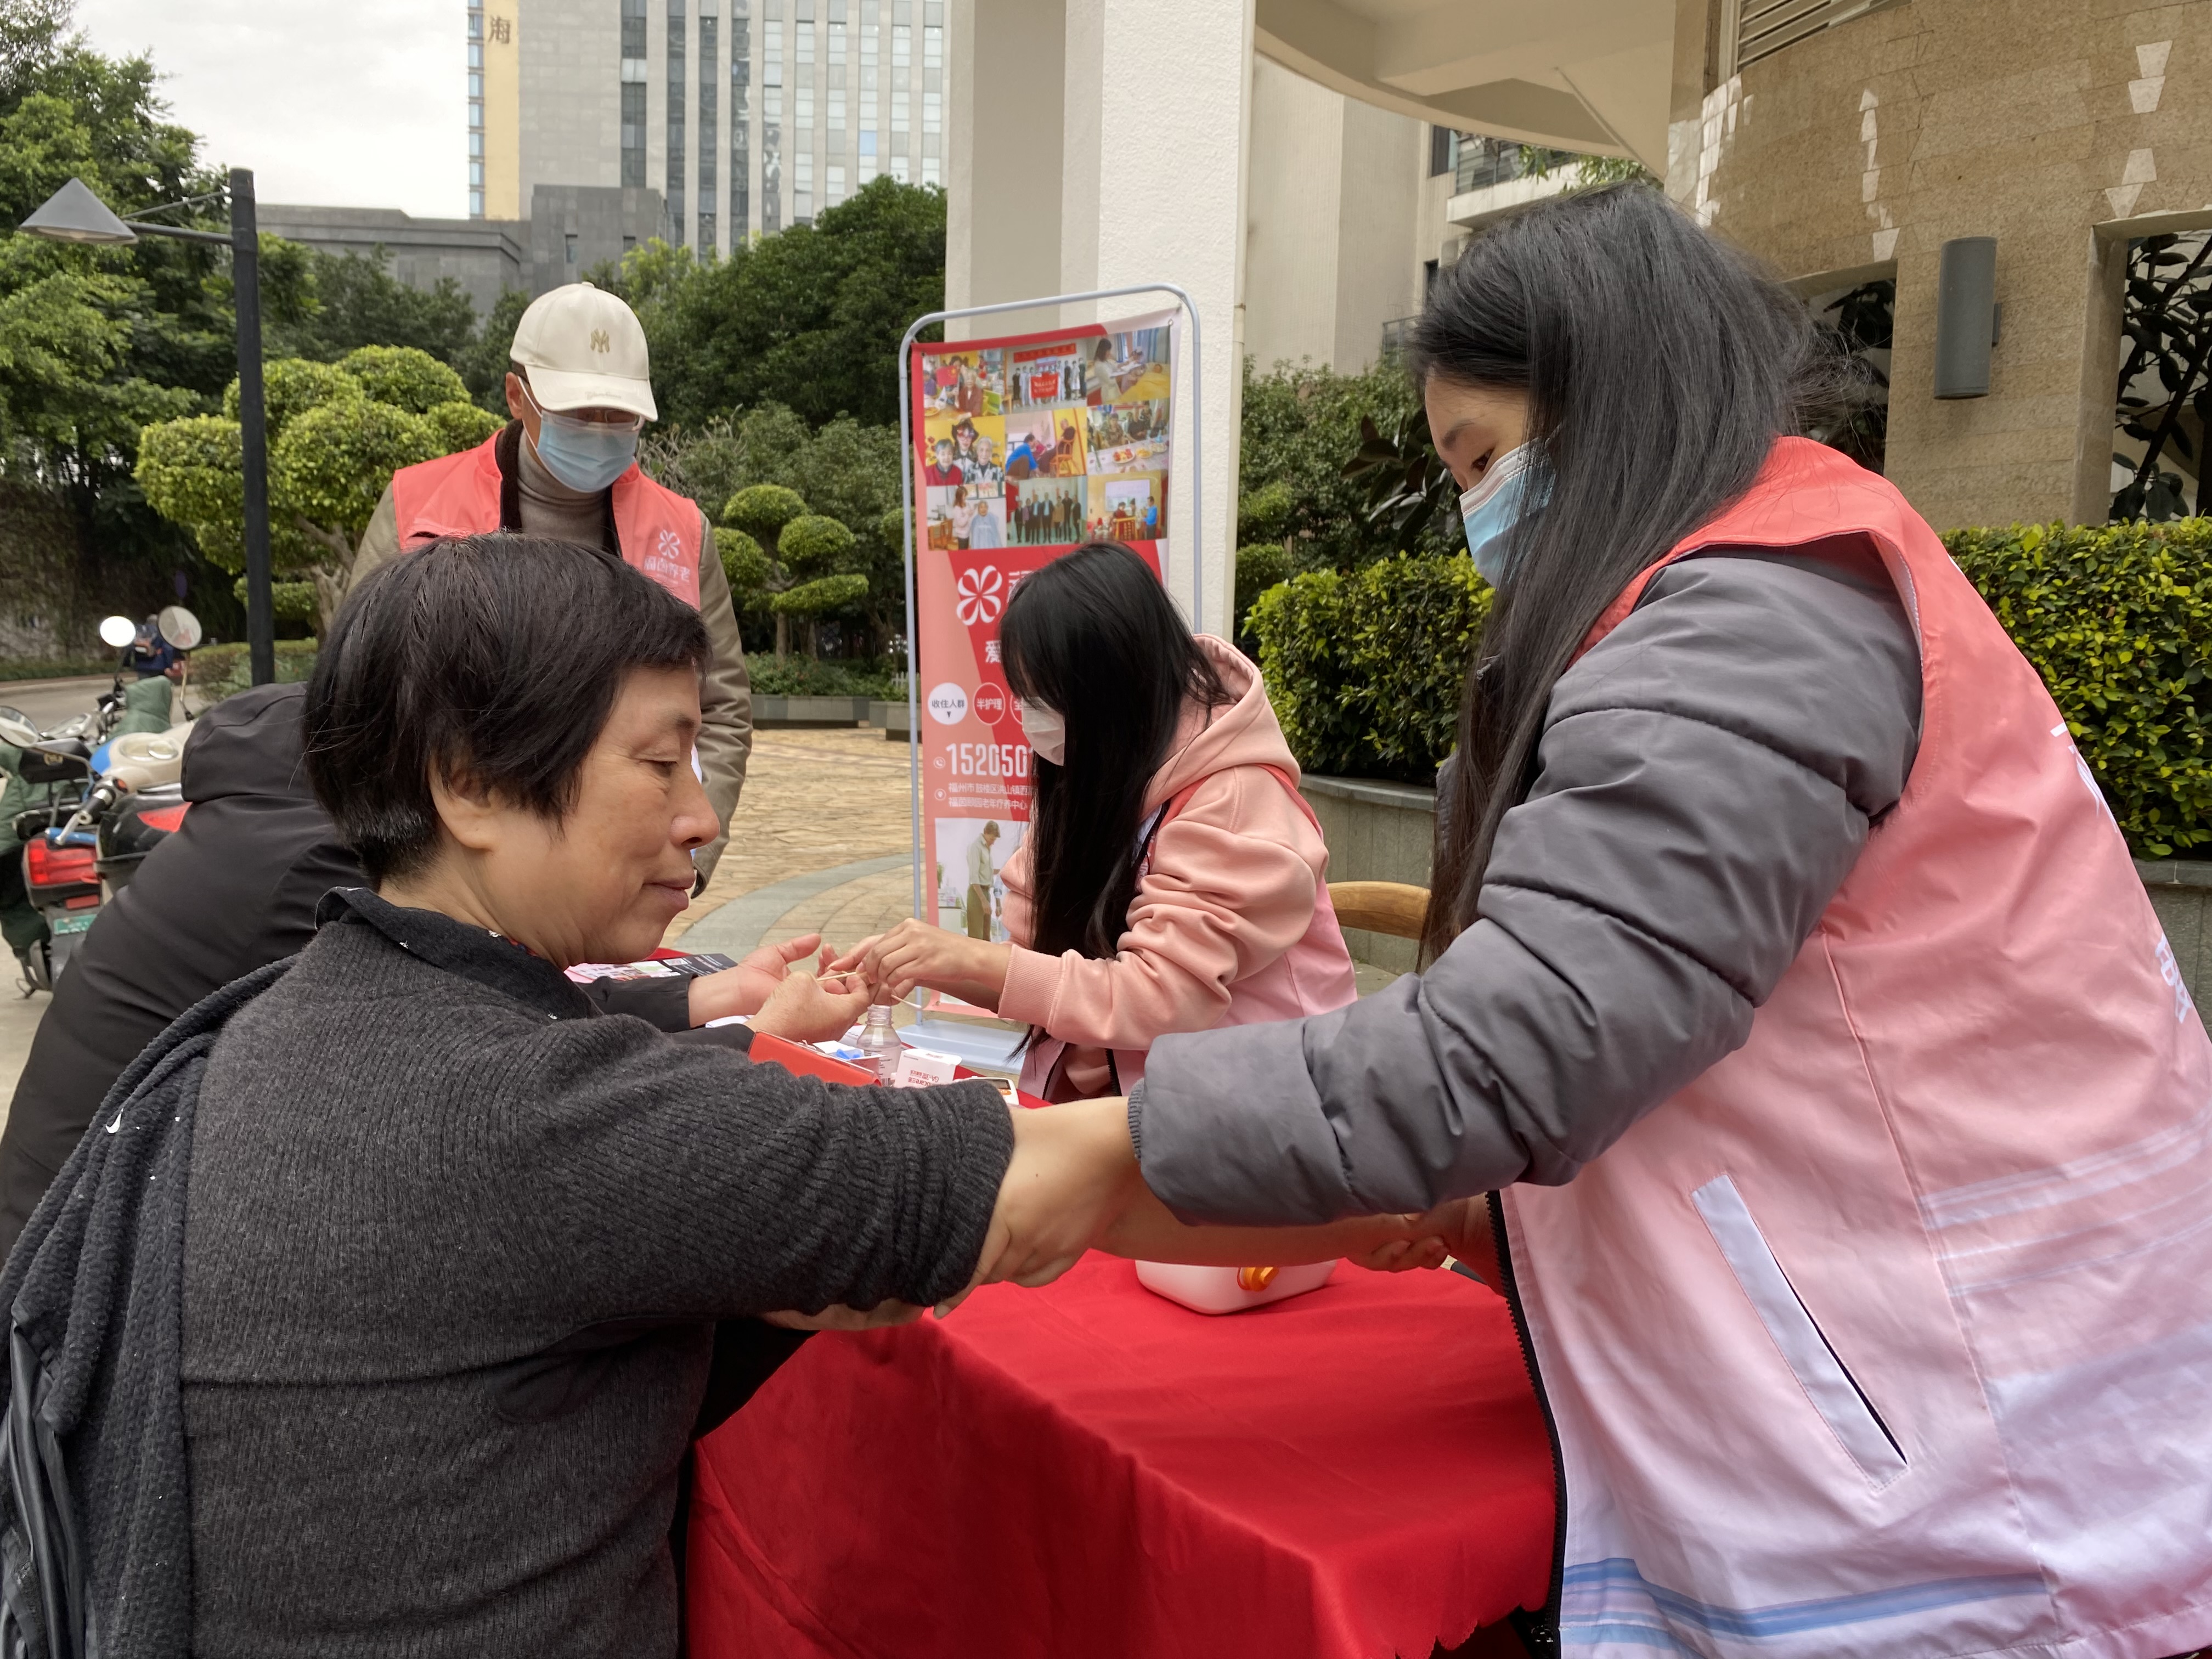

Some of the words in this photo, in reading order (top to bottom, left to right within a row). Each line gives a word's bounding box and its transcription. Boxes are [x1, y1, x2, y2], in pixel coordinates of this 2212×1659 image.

[932, 699, 964, 708] 收住人群
[977, 698, 1003, 710] 半护理
